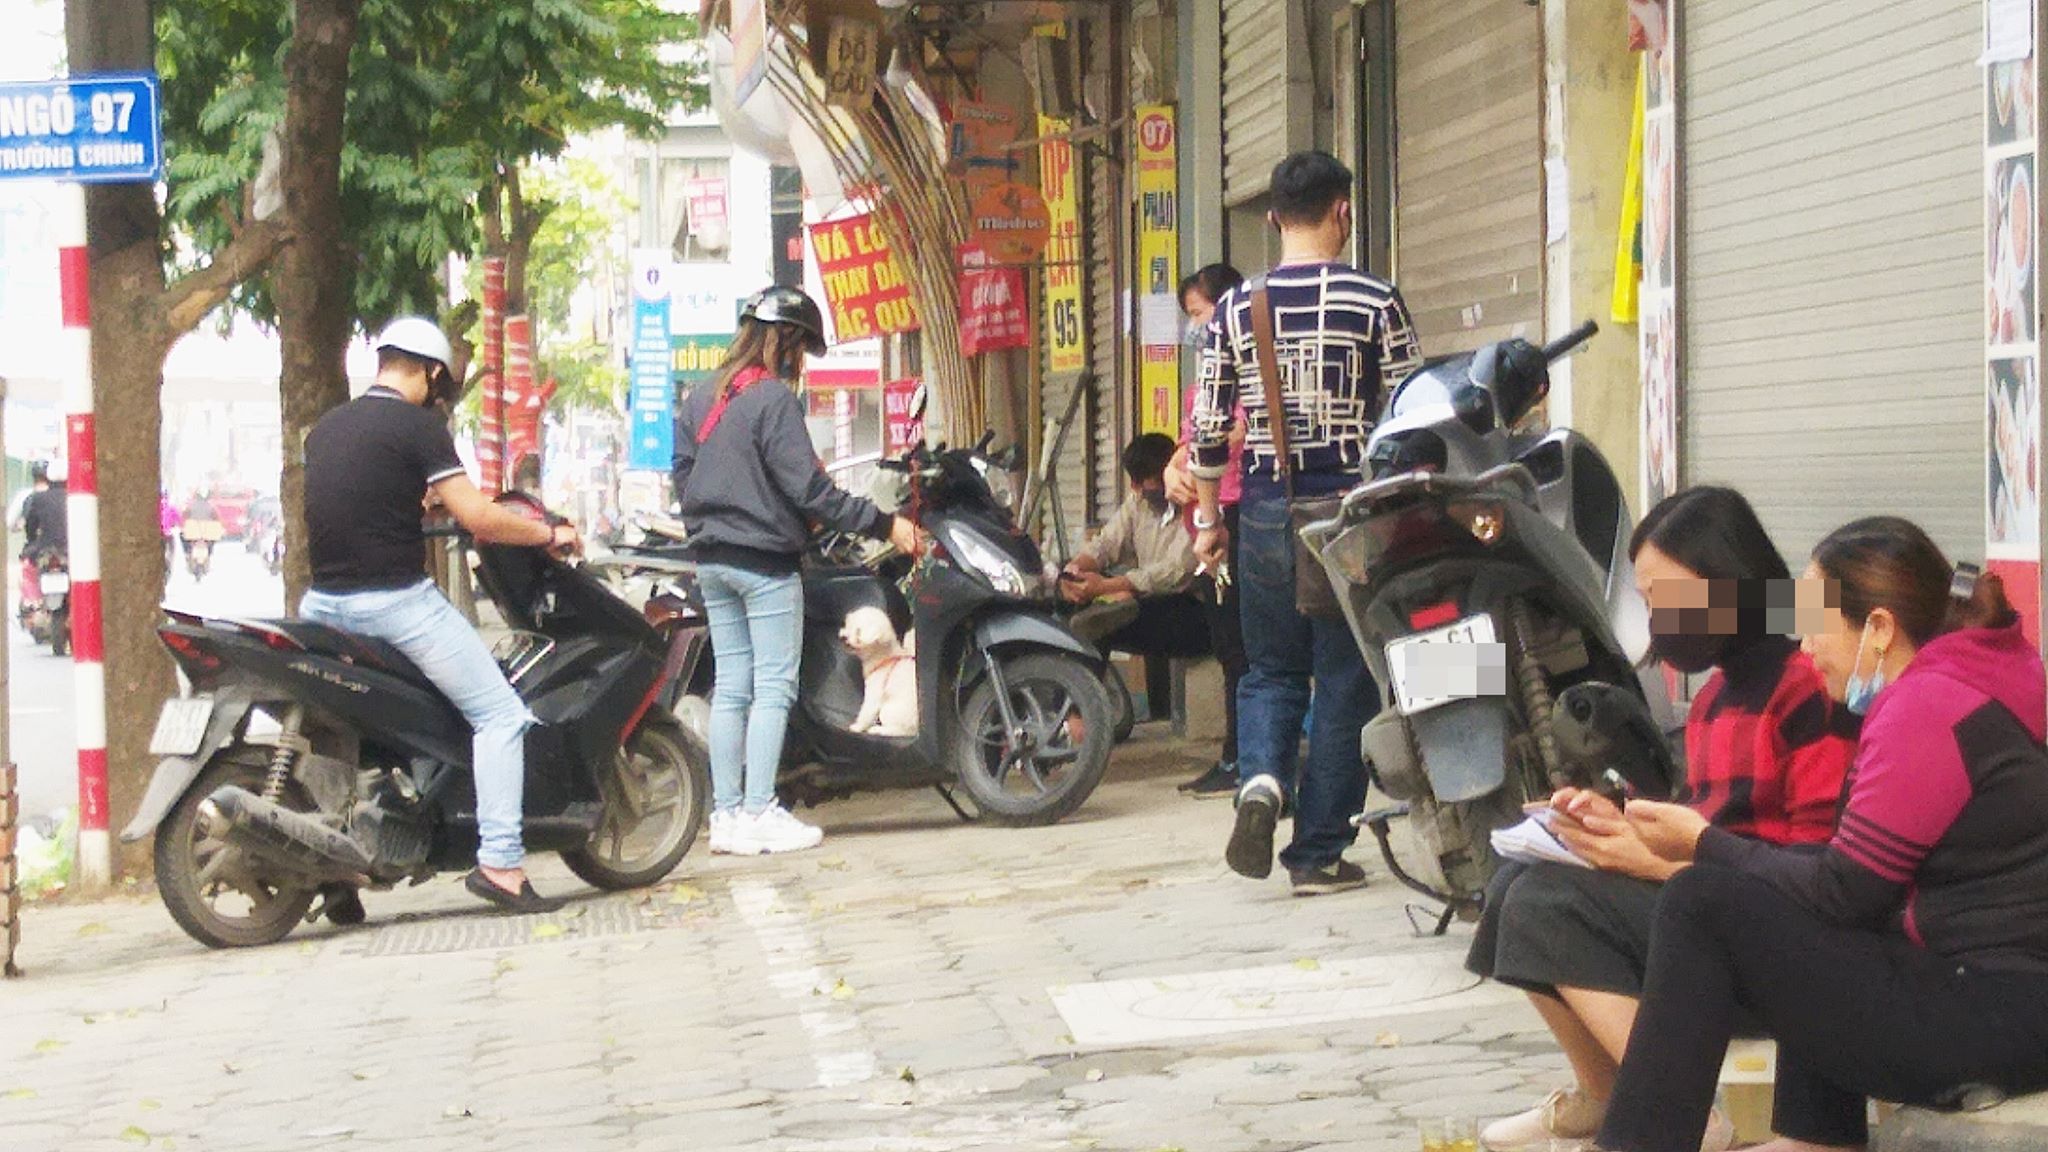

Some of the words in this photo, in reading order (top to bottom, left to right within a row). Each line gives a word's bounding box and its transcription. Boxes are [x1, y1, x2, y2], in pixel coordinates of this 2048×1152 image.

[0, 86, 74, 138] NGÕ
[91, 91, 136, 134] 97
[78, 143, 145, 167] CHINH
[813, 224, 851, 263] VÁ
[823, 265, 871, 301] THAY
[1053, 299, 1077, 349] 95
